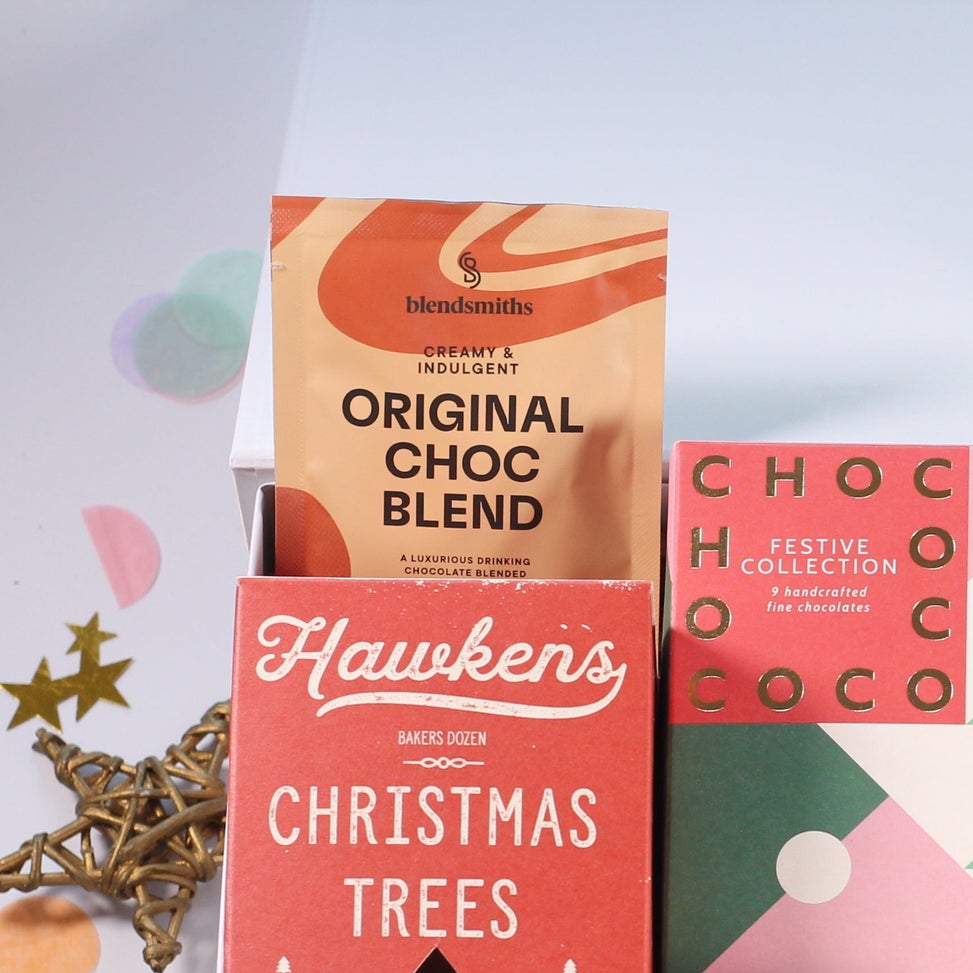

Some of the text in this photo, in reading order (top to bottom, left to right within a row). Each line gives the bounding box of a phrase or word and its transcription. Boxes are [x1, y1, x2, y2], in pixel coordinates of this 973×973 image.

[406, 296, 534, 315] blendsmiths
[424, 346, 514, 358] CREAMY &
[418, 362, 519, 376] INDULGENT
[342, 388, 584, 433] ORIGINAL
[384, 442, 540, 483] CHOC
[382, 490, 544, 531] BLEND
[770, 538, 869, 555] FESTIVE
[400, 554, 531, 566] A LUXURIOUS DRINKING
[740, 558, 897, 575] COLLECTION
[404, 566, 526, 578] CHOCOLATE BLENDED
[771, 586, 868, 598] 9 handcrafted
[766, 602, 870, 614] fine chocolates
[254, 614, 628, 720] Hawkens
[398, 730, 487, 746] BAKERS DOZEN
[268, 785, 598, 848] CHRISTMAS
[343, 878, 518, 939] TREES
